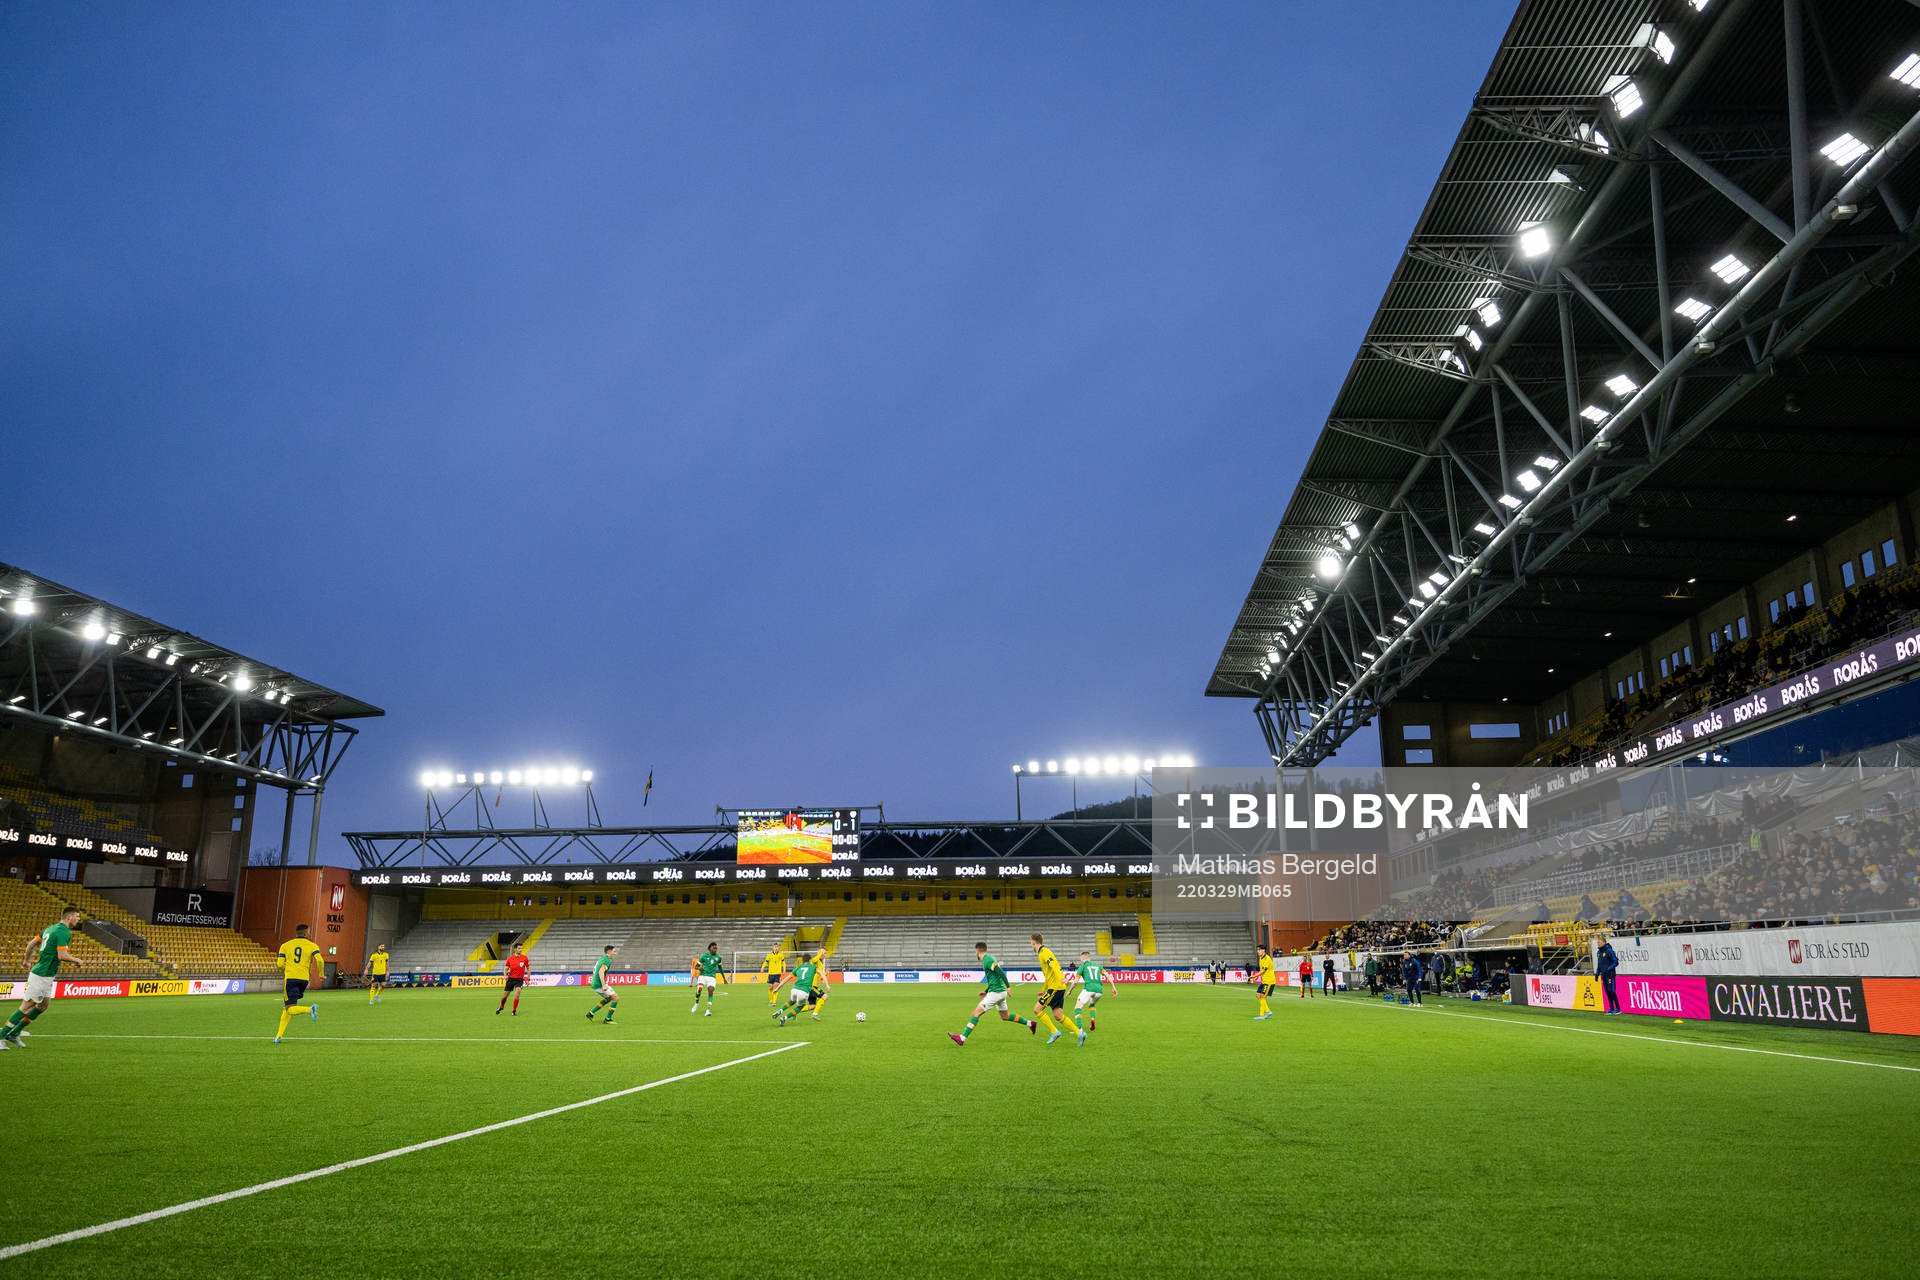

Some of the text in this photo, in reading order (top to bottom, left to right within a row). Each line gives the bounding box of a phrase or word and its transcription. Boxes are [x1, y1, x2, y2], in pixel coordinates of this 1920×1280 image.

[1595, 753, 1616, 774] BORÅS
[1624, 741, 1648, 763] BORÅS
[1656, 727, 1682, 751] BORÅS
[1693, 712, 1722, 738] BORÅS
[1734, 695, 1767, 723] BORÅS
[1781, 674, 1820, 705] BORÅS
[1833, 652, 1878, 686] BORÅS
[834, 819, 841, 831] 0
[851, 819, 855, 831] 1
[29, 833, 57, 846] BORÅS
[67, 837, 93, 850] BORÅS
[102, 843, 127, 855] BORÅS
[135, 846, 158, 858] BORÅS
[166, 850, 188, 862] BORÅS
[832, 850, 859, 860] BORÅS
[361, 874, 390, 885] BORÅS
[402, 873, 431, 884] BORÅS
[441, 872, 471, 883] BORÅS
[482, 871, 511, 882] BORÅS
[523, 871, 552, 882] BORÅS
[565, 870, 594, 881] BORÅS
[606, 869, 636, 880] BORÅS
[653, 868, 683, 880] BORÅS
[695, 867, 725, 879] BORÅS
[736, 867, 766, 879] BORÅS
[778, 866, 808, 878] BORÅS
[821, 866, 851, 878] BORÅS
[864, 865, 894, 877] BORÅS
[907, 865, 938, 876] BORÅS
[955, 864, 986, 876] BORÅS
[999, 863, 1030, 875] BORÅS
[1041, 863, 1072, 875] BORÅS
[1084, 862, 1116, 874] BORÅS
[1128, 862, 1160, 874] BORÅS
[157, 912, 228, 926] FASTIGHETSSERVICE
[326, 912, 344, 923] BORÅS
[326, 924, 341, 933] STAD
[293, 947, 302, 964] 9
[1696, 943, 1742, 961] BORÅS STAD
[1805, 940, 1870, 959] BORÅS STAD
[801, 968, 808, 980] 7
[1021, 973, 1037, 982] ICA
[1087, 966, 1099, 980] 17
[1541, 983, 1562, 994] SVENSKA
[1542, 994, 1553, 1005] SPEL
[1627, 980, 1683, 1012] Folksam
[1714, 983, 1857, 1023] CAVALIERE
